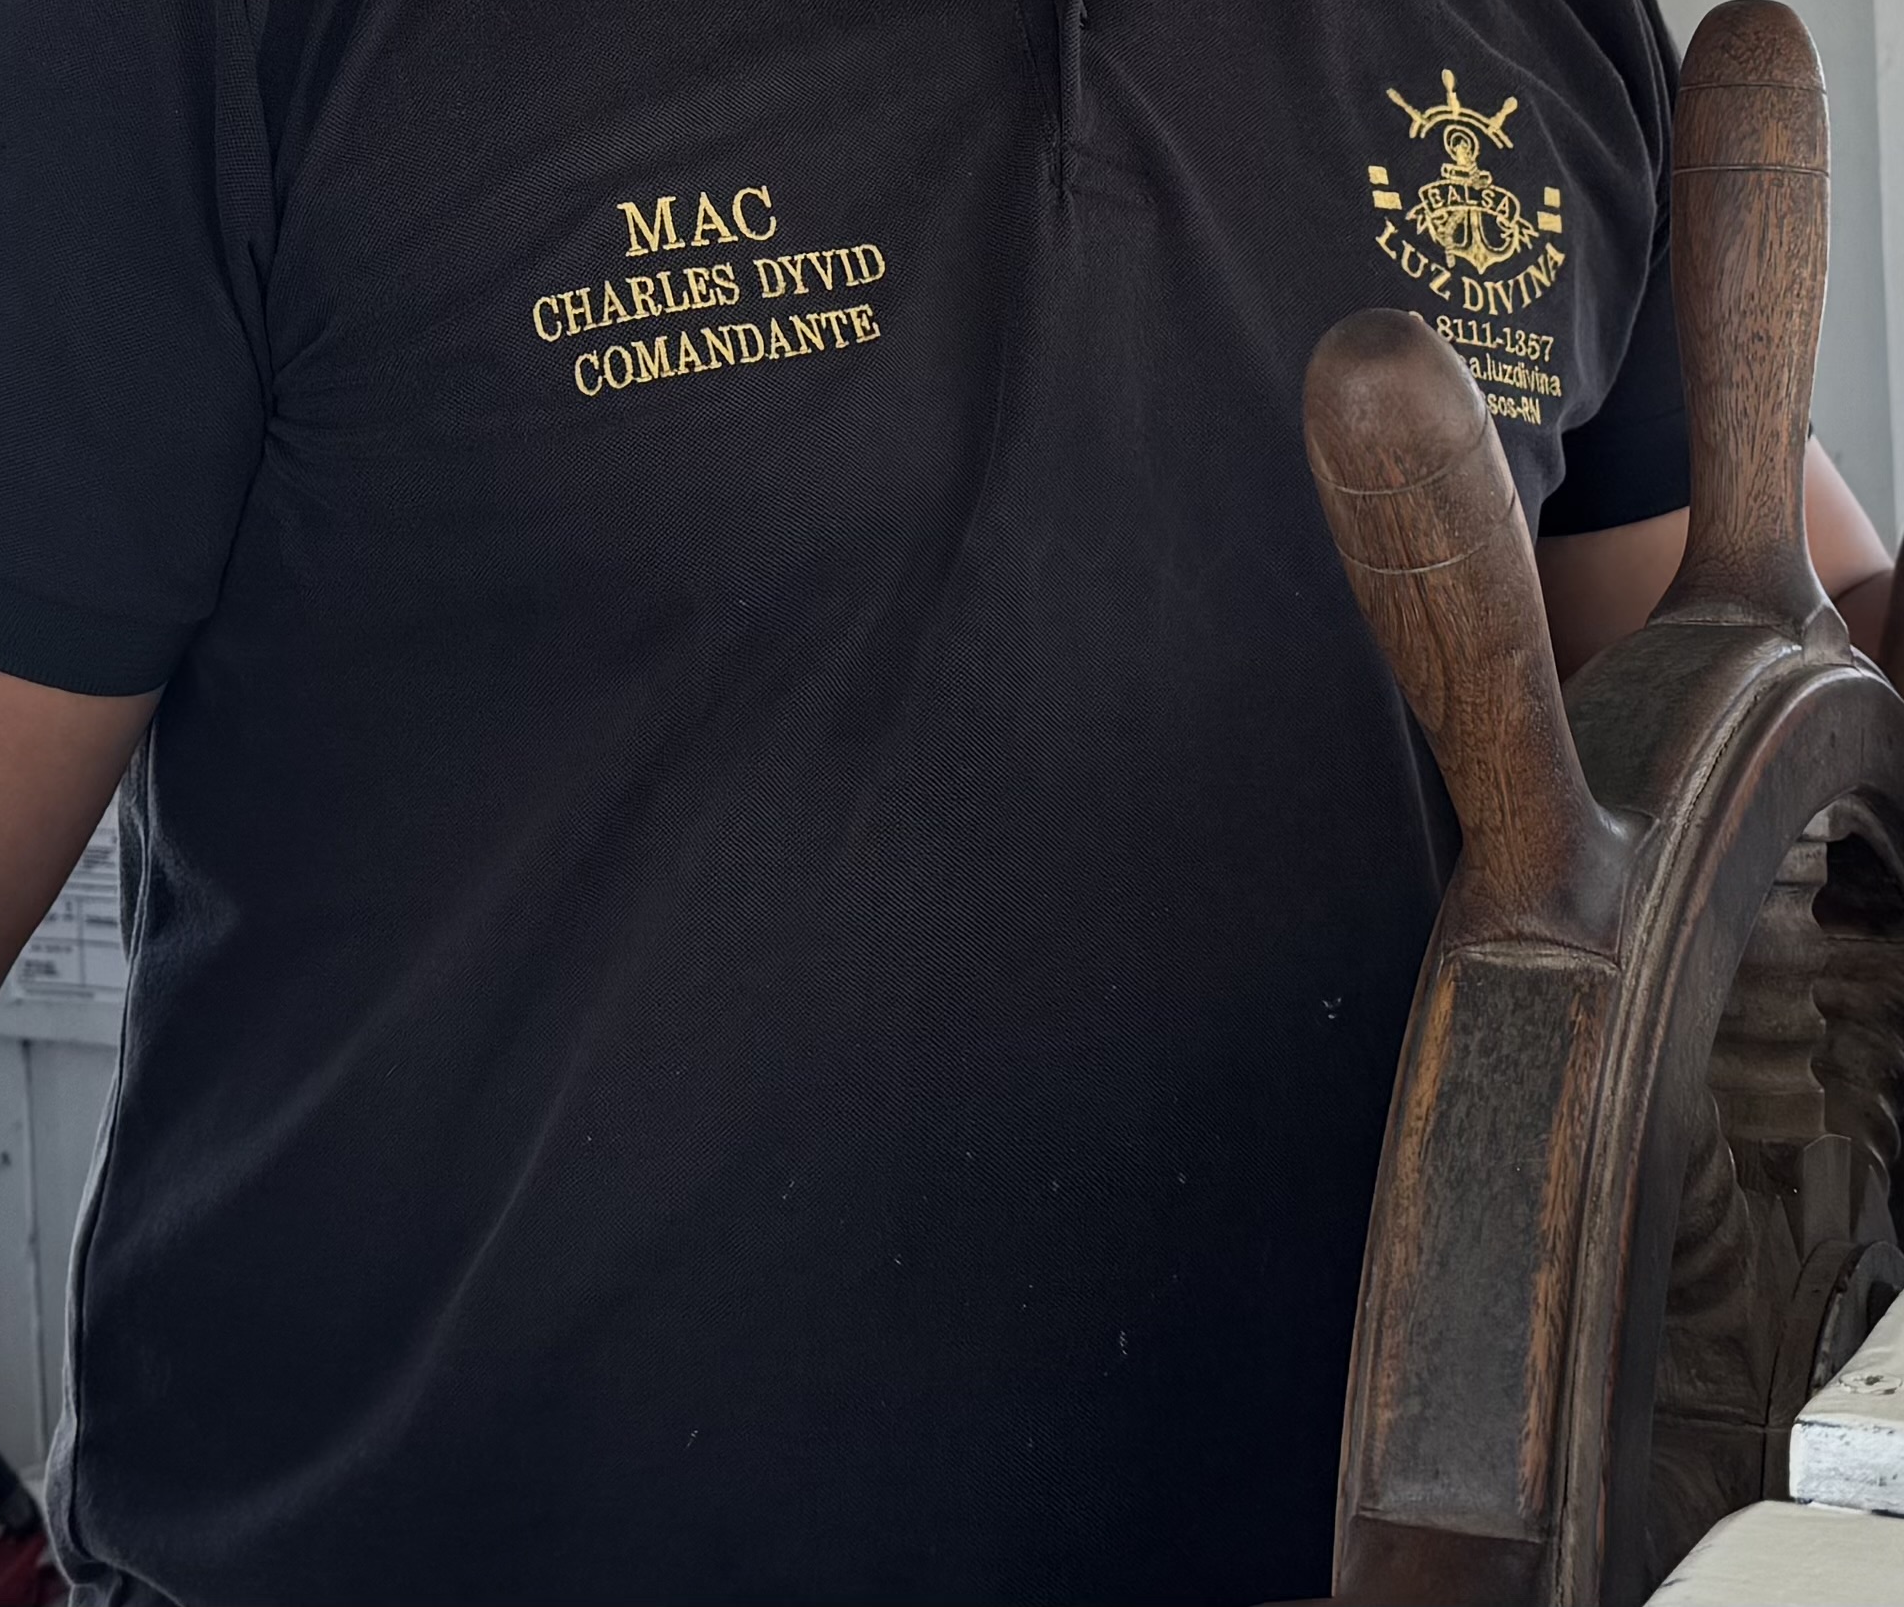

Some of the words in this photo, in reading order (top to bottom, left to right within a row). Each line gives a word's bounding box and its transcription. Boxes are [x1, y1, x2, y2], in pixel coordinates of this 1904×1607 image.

[616, 185, 778, 258] MAC
[1427, 184, 1509, 218] BALSA
[532, 261, 740, 343] CHARLES
[754, 242, 886, 300] DYVID
[1375, 219, 1451, 300] LUZ
[1461, 242, 1567, 316] DIVINA
[574, 303, 882, 396] COMANDANTE
[1482, 391, 1542, 426] sos-RN
